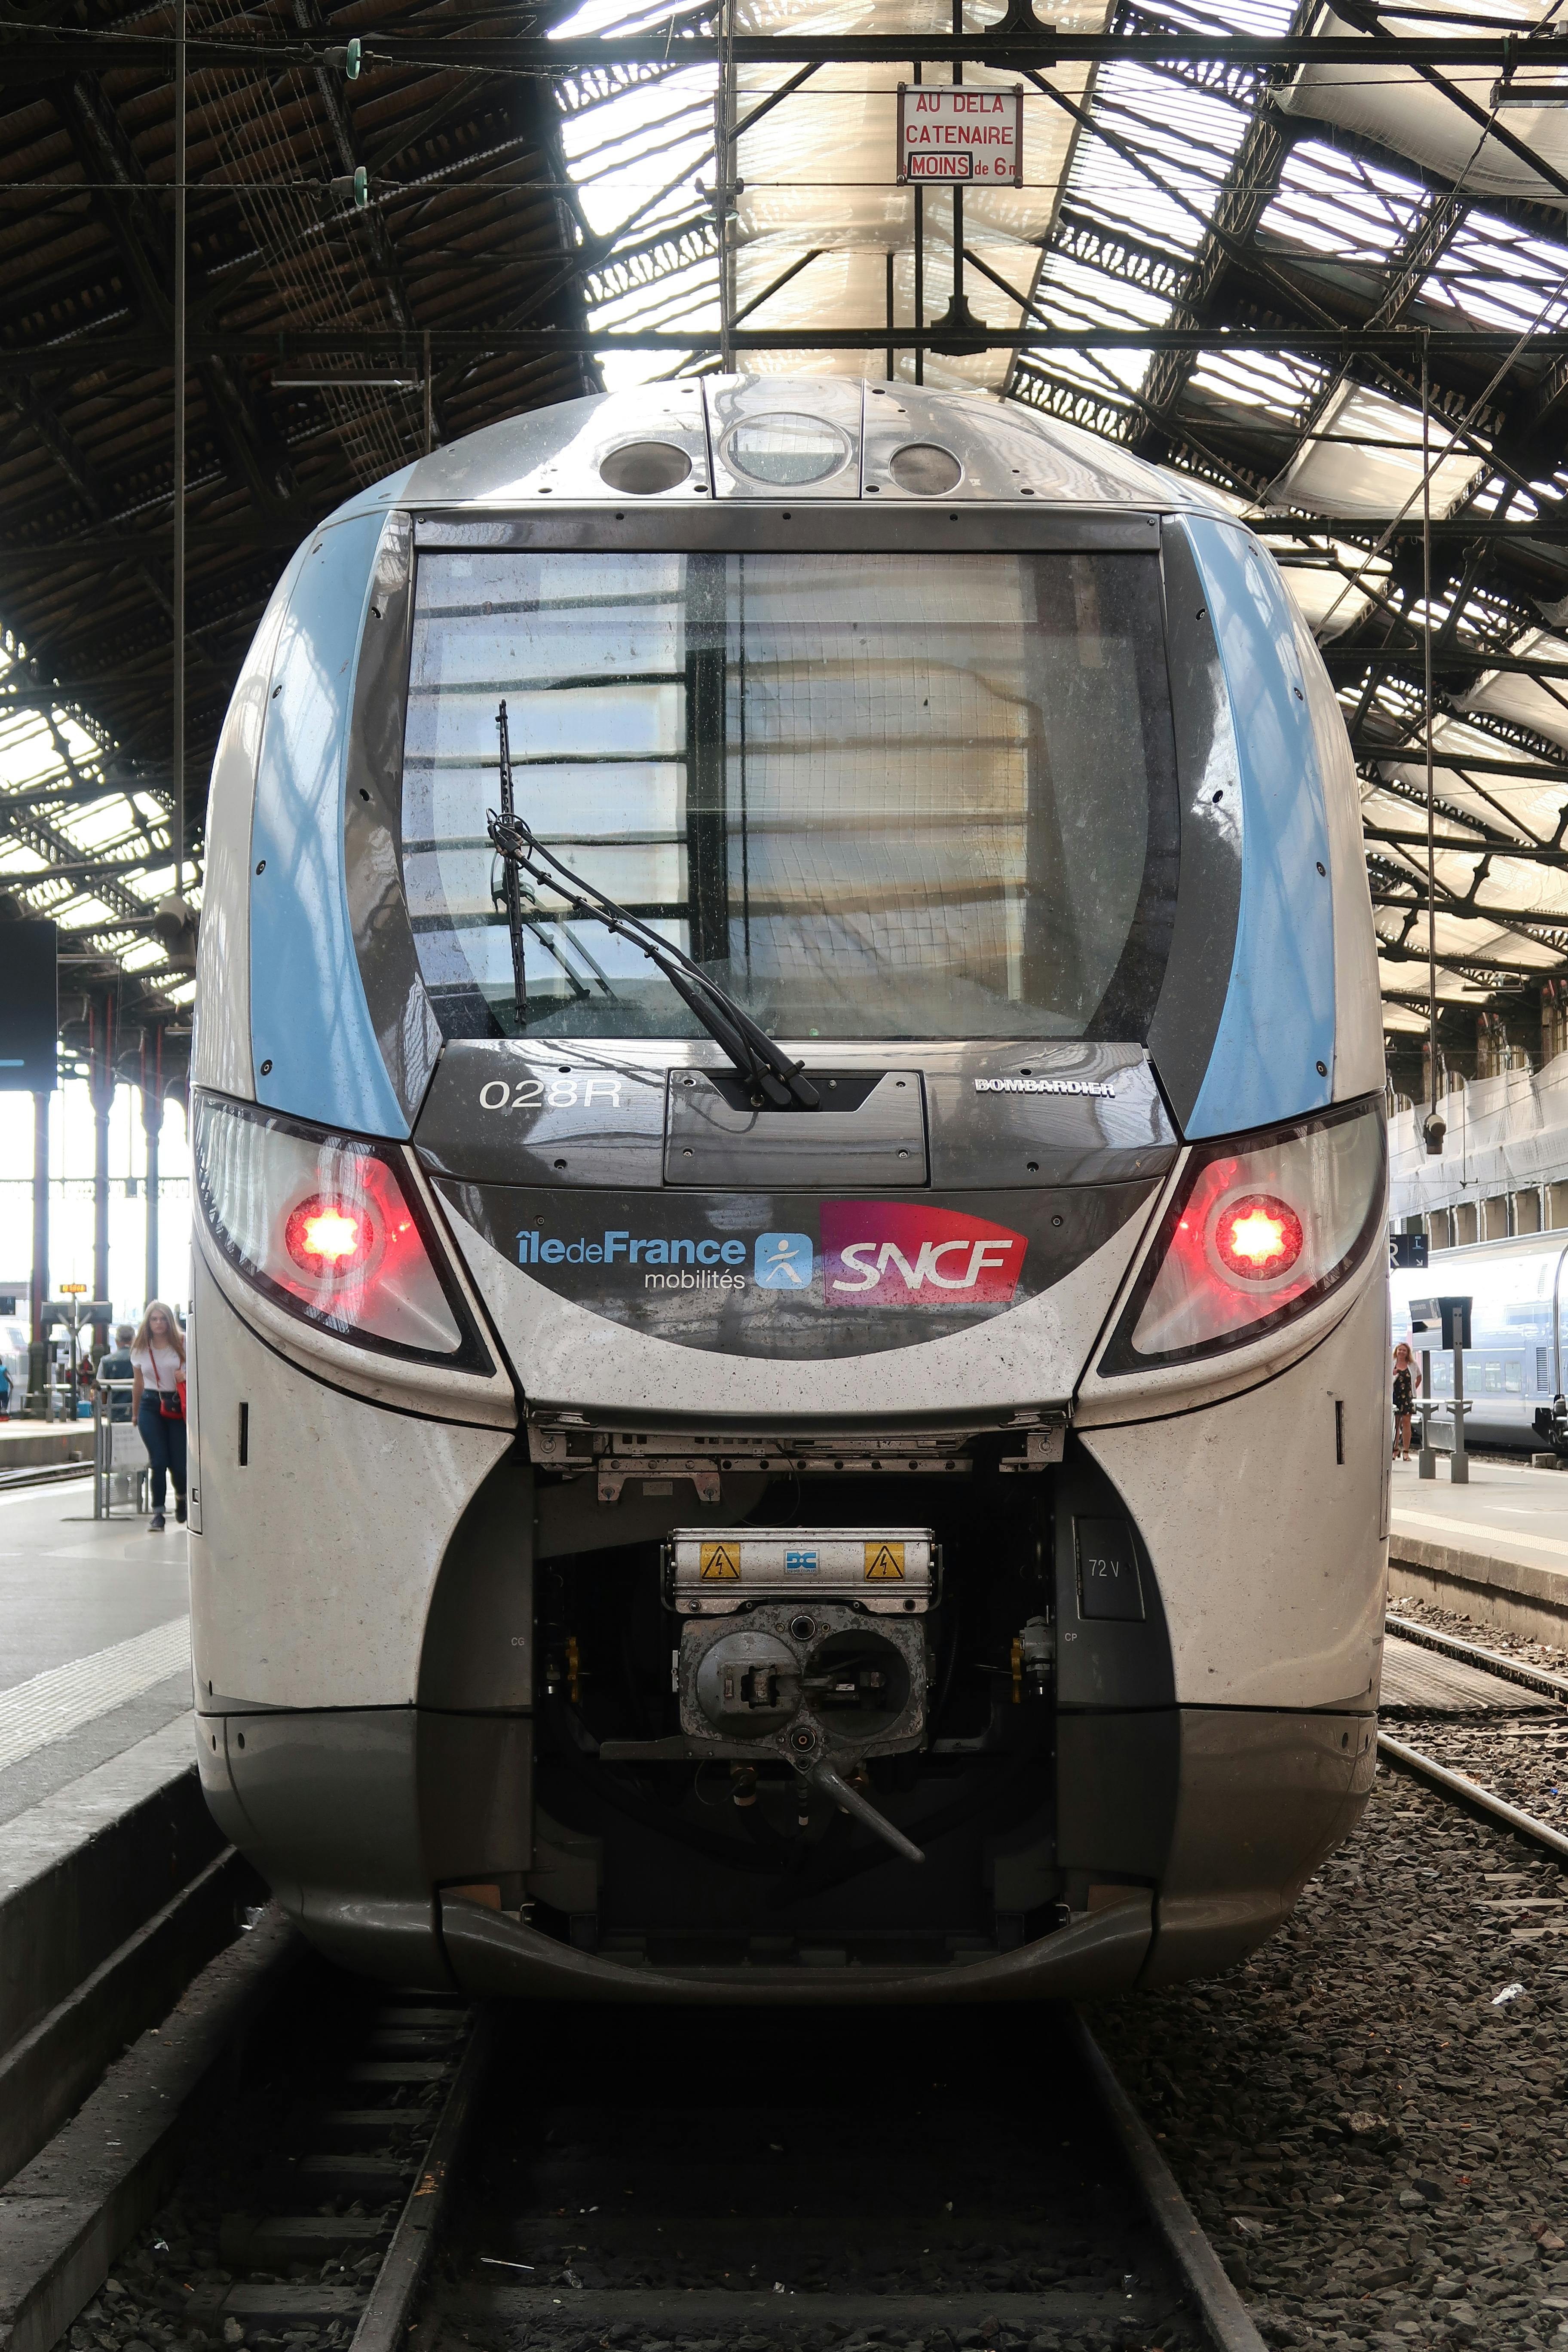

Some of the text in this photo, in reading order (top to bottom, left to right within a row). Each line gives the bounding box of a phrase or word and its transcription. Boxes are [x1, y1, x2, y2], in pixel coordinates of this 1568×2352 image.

[916, 93, 1004, 113] AU DELA
[906, 125, 1014, 144] CATENAIRE
[913, 156, 968, 175] MOINS
[974, 159, 989, 175] de
[479, 1079, 622, 1110] 028R
[974, 1078, 1115, 1098] BOMBARDIER
[832, 1240, 1014, 1292] SNCF
[645, 1269, 745, 1289] mobilités
[1089, 1559, 1119, 1577] 72 V
[511, 1637, 525, 1646] CG
[1064, 1633, 1078, 1642] CP
